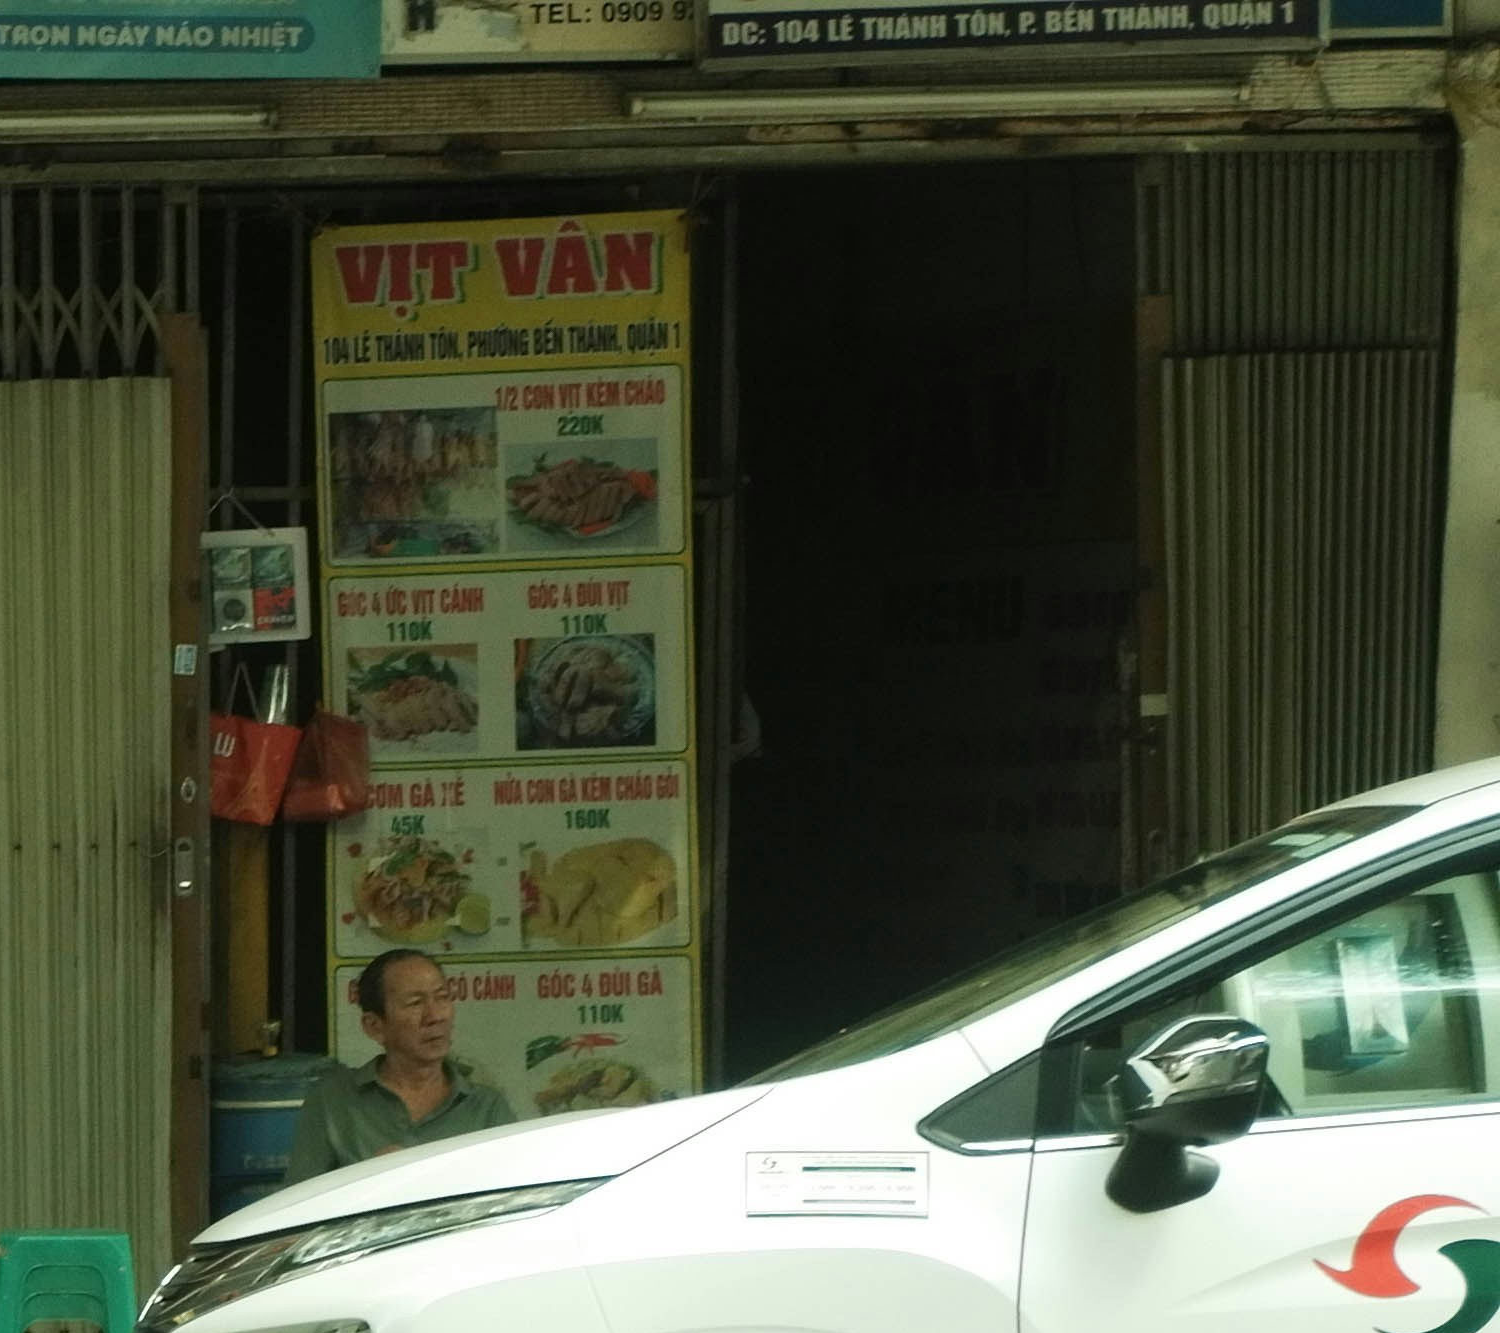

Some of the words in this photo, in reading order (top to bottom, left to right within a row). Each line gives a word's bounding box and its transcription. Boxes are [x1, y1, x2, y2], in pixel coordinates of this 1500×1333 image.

[531, 4, 592, 24] TEL:
[601, 1, 662, 23] 0909
[773, 18, 820, 44] 104
[1018, 10, 1036, 35] P.
[1280, 1, 1294, 25] 1
[77, 20, 150, 46] NGÀY
[156, 20, 214, 47] NÁO
[334, 240, 475, 320] VỊT
[494, 218, 660, 299] VÂN
[323, 335, 349, 364] 104
[672, 320, 681, 350] 1
[494, 385, 519, 412] 1/2
[523, 384, 554, 410] CON
[557, 415, 604, 436] 220K
[371, 591, 382, 615] 4
[562, 583, 573, 608] 4
[386, 620, 433, 642] 110K
[560, 613, 608, 635] 110K
[526, 778, 556, 804] CON
[391, 814, 425, 835] 45K
[564, 808, 610, 829] 160K
[538, 968, 575, 999] GÓC
[581, 972, 594, 998] 4
[578, 1004, 625, 1025] 110K
